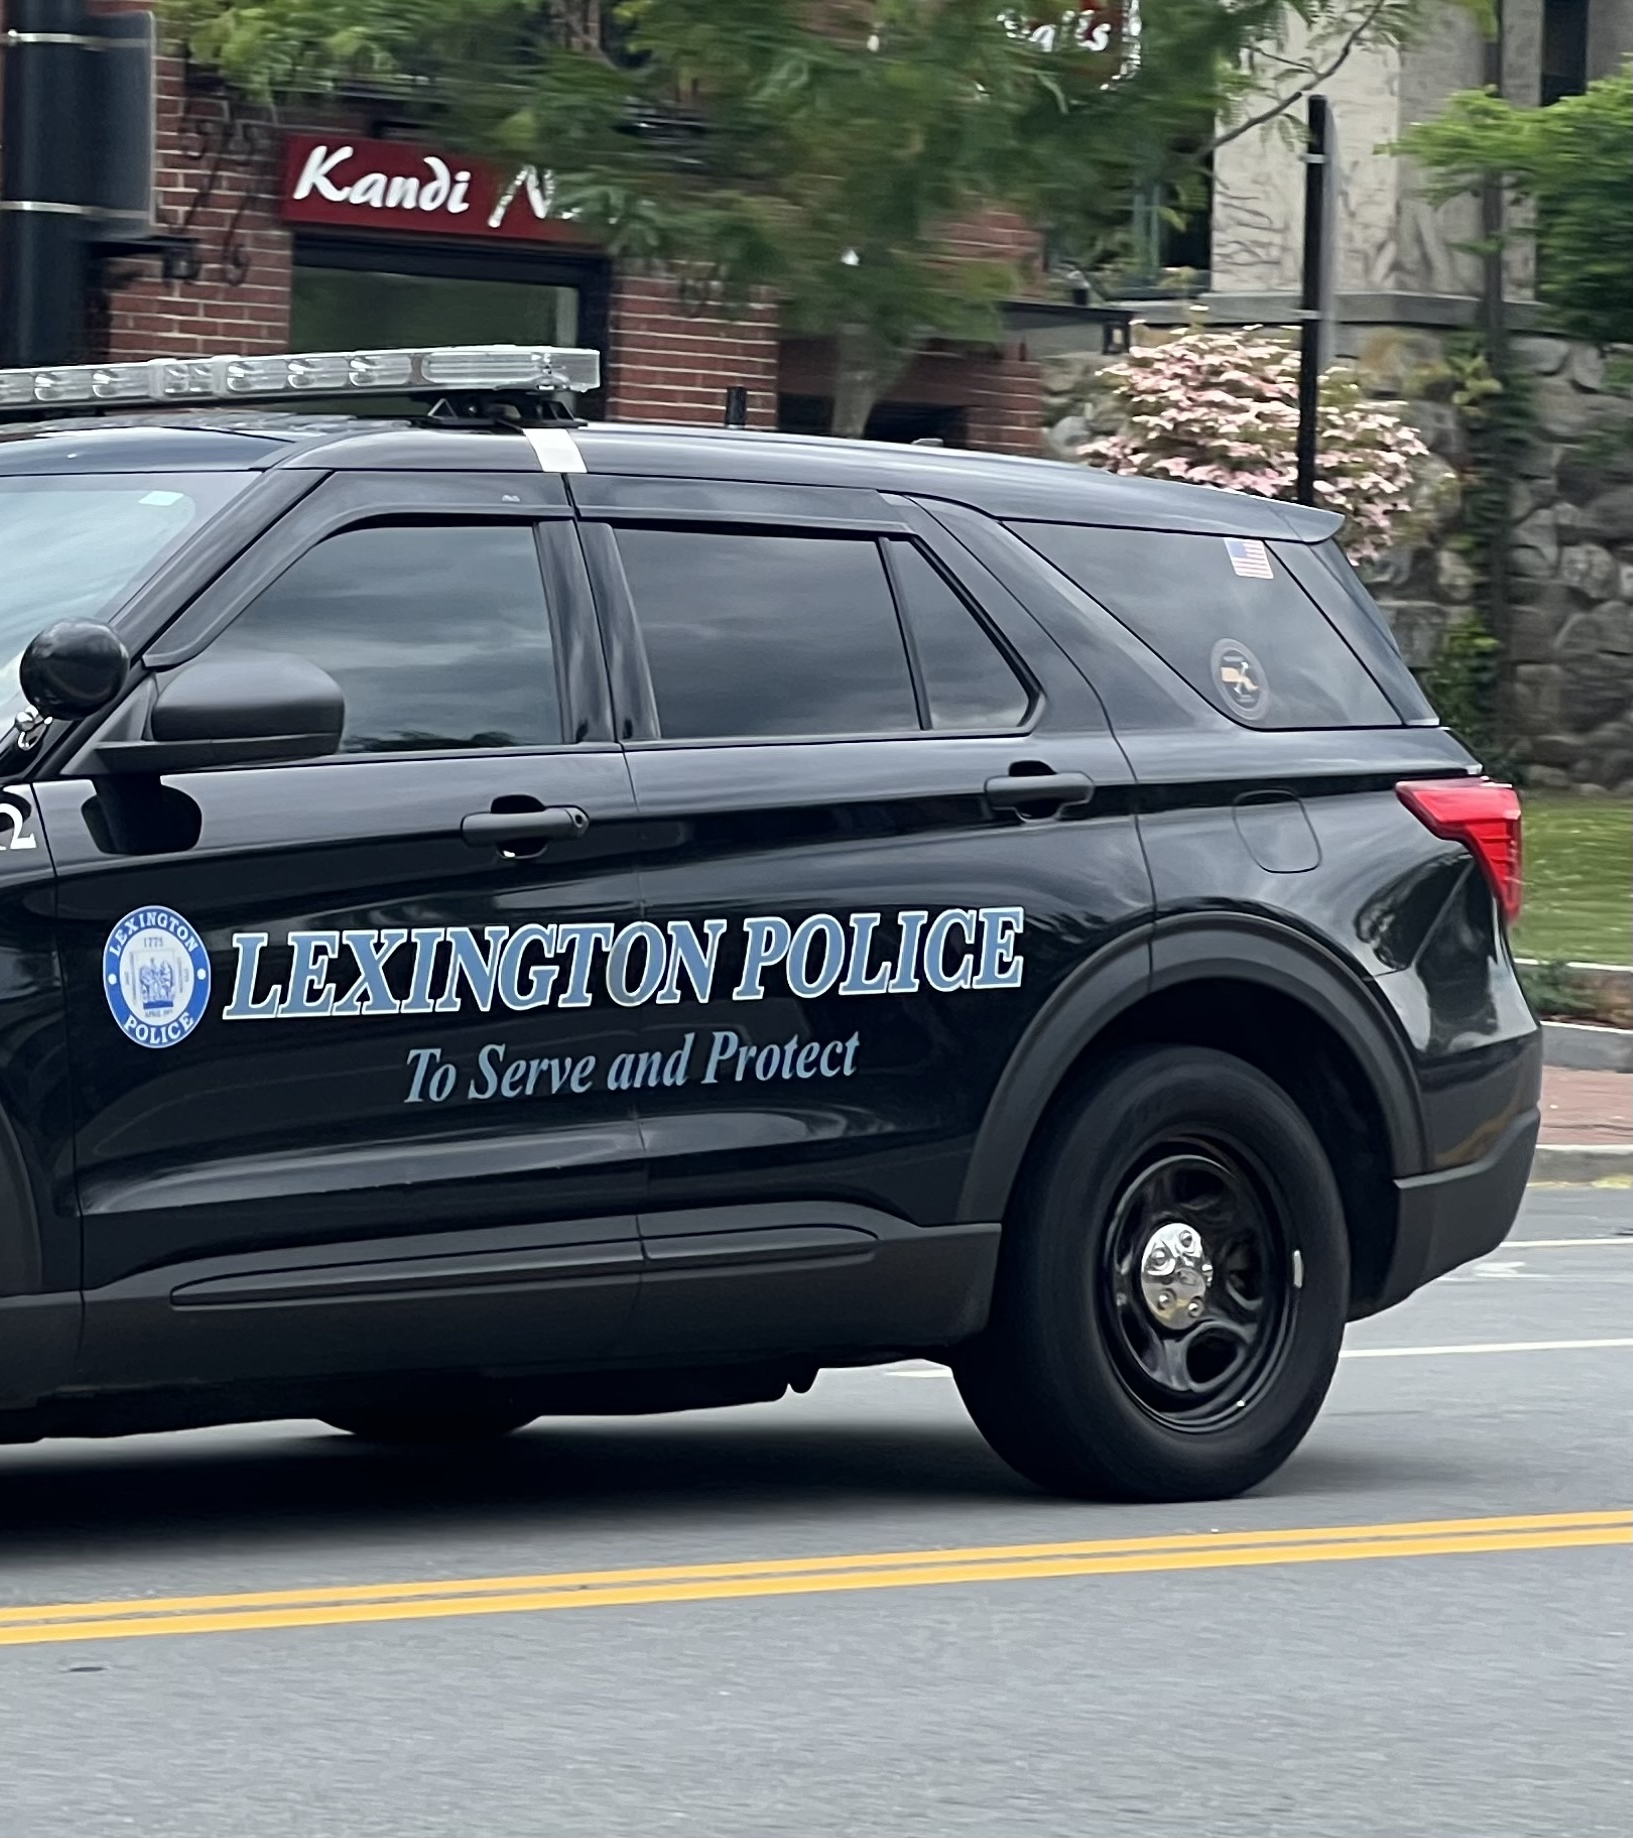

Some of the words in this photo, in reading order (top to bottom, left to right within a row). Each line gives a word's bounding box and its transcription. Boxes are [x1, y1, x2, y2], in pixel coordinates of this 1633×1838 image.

[293, 145, 471, 214] Kandi
[109, 911, 198, 957] LEXINGTON
[222, 919, 727, 1020] LEXINGTON
[733, 907, 1024, 1000] POLICE
[124, 1011, 194, 1045] POLICE
[404, 1048, 457, 1103] To
[469, 1043, 596, 1101] Serve
[607, 1031, 695, 1091] and
[701, 1030, 860, 1085] Protect
